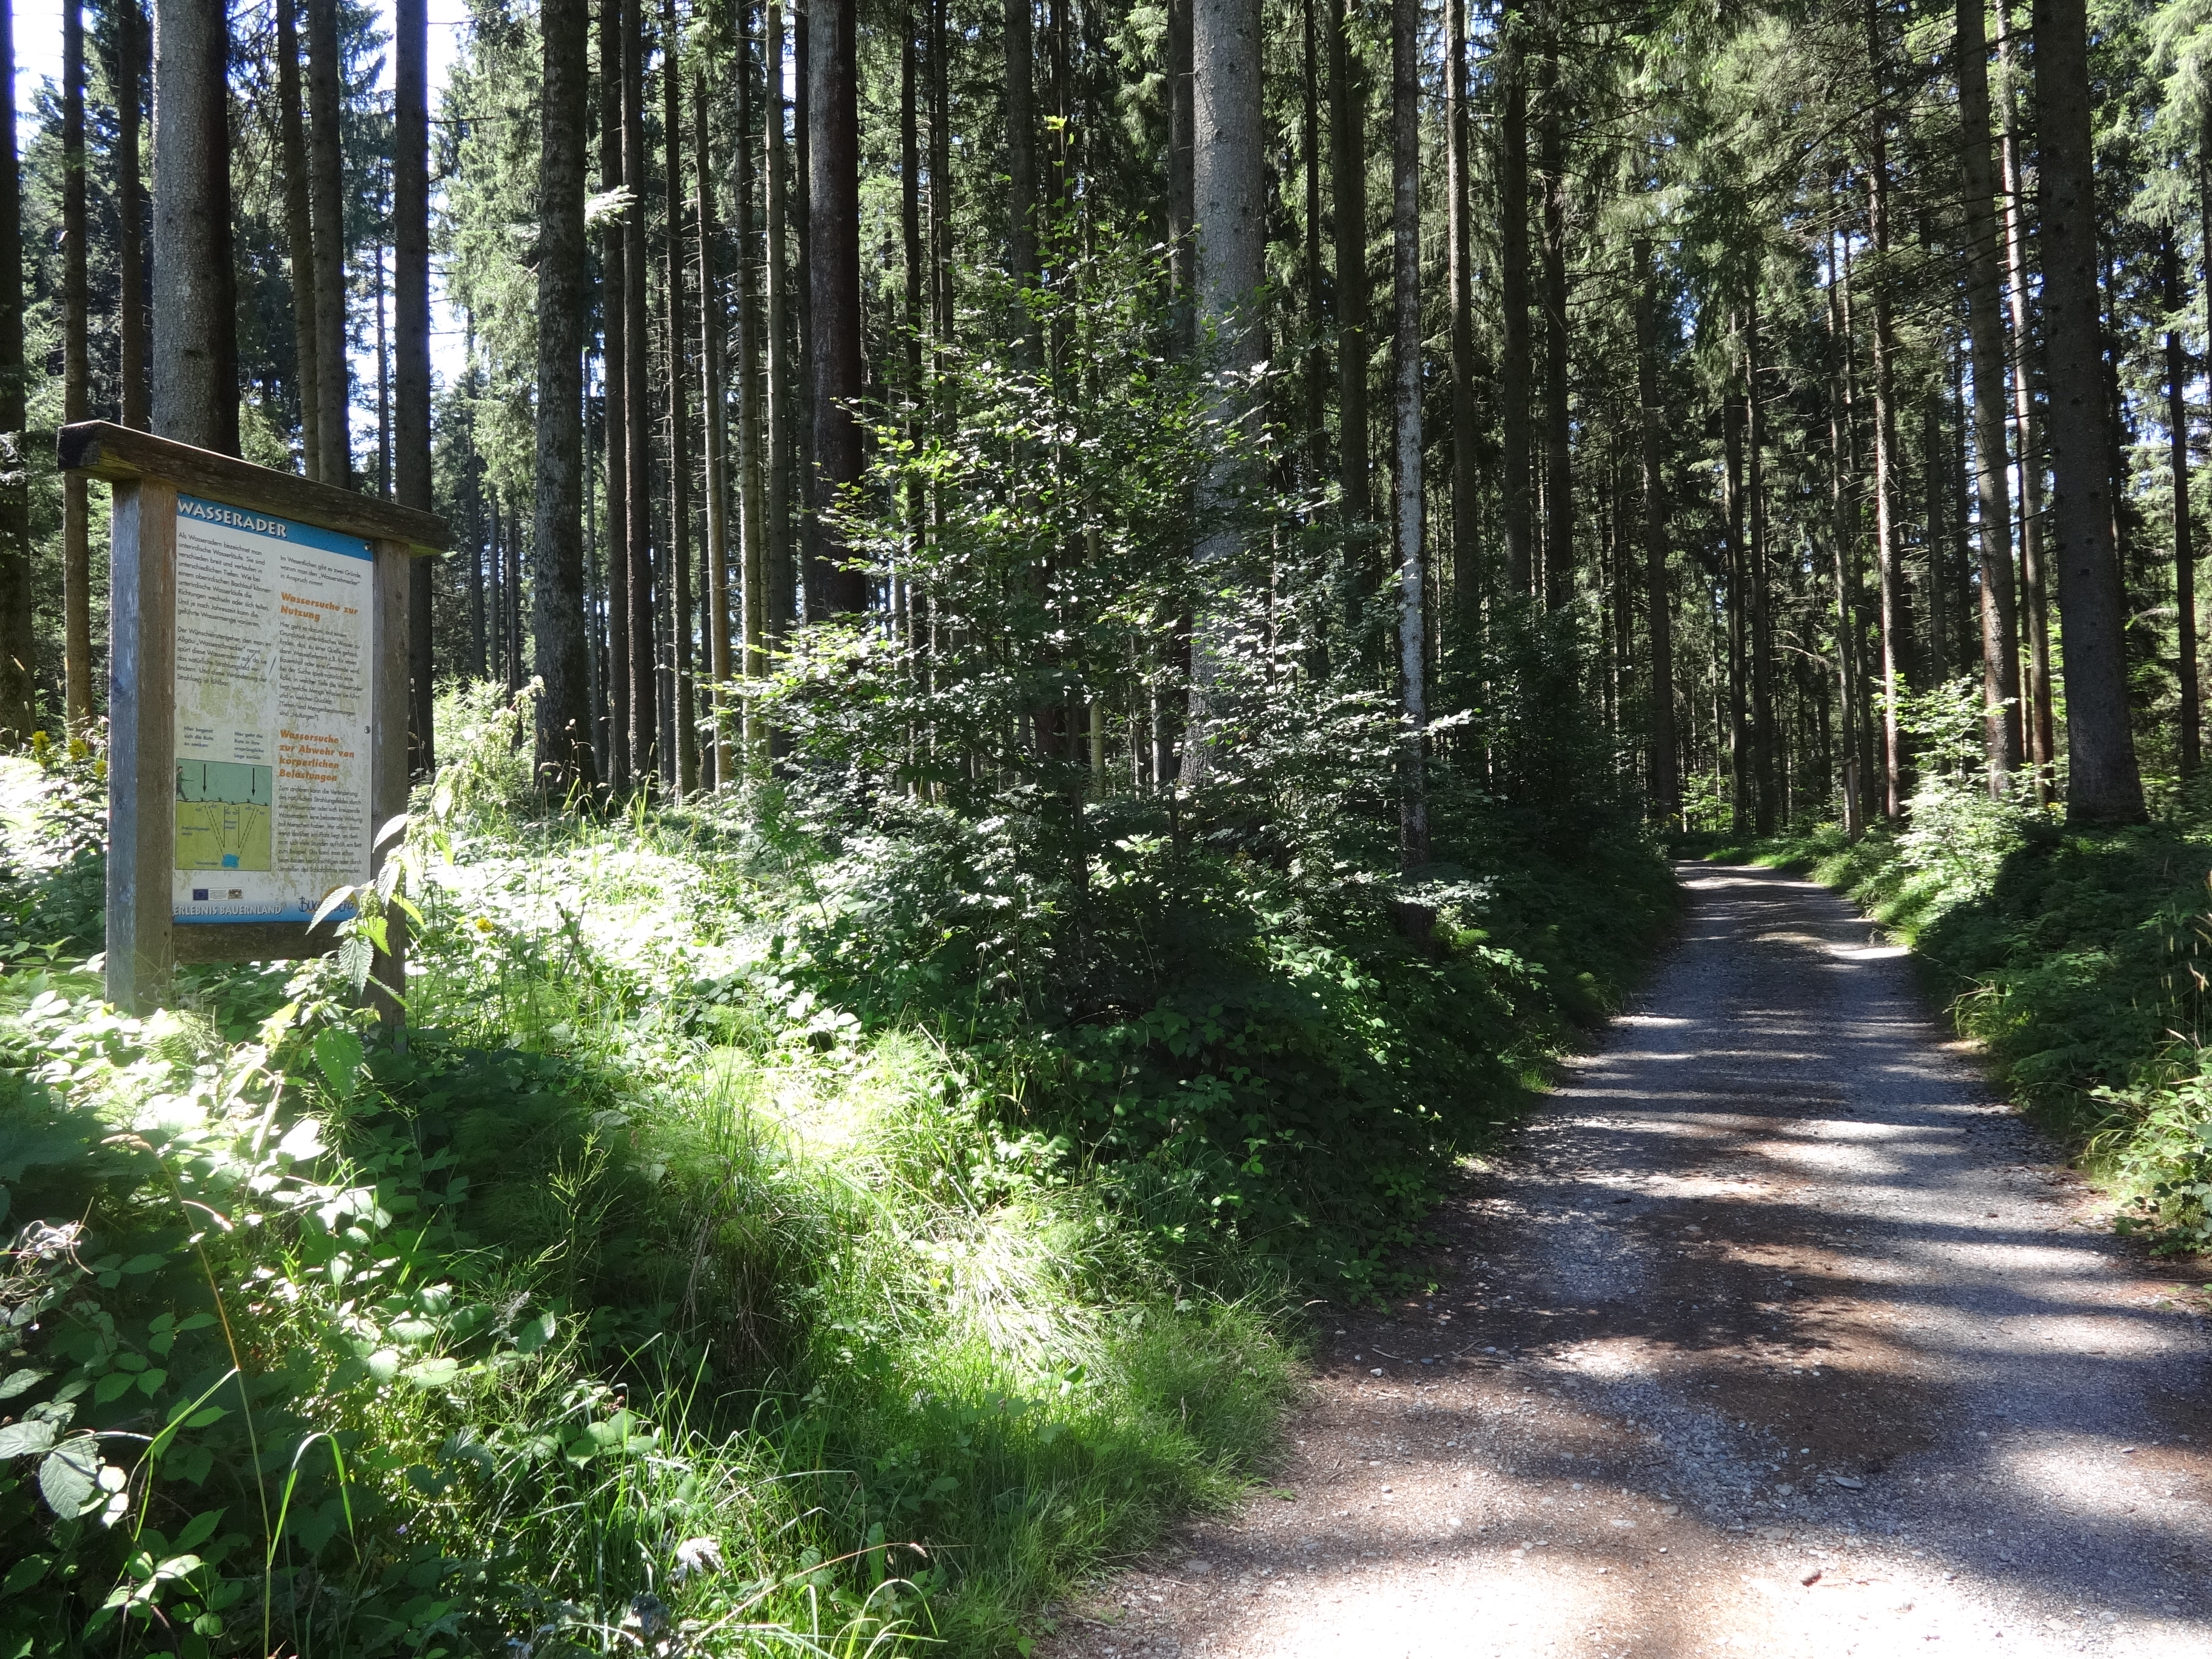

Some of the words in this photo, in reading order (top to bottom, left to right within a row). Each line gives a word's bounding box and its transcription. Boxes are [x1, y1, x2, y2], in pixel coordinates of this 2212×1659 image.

[177, 498, 287, 538] WASSERADER
[189, 534, 222, 546] Wasseradern
[224, 542, 250, 552] bezeichnet
[178, 541, 211, 554] unterirdische
[213, 549, 244, 561] Wasserläufe.
[178, 551, 209, 562] verschieden
[234, 562, 256, 572] verlaufen
[178, 560, 221, 574] unterschiedlichen
[287, 557, 317, 568] Wesentlichen
[345, 569, 362, 579] Gründe,
[178, 569, 193, 578] einem
[195, 573, 229, 585] oberirdischen
[231, 580, 252, 589] Bachlauf
[253, 585, 270, 593] können
[286, 574, 307, 585] Anspruch
[178, 579, 210, 590] unterirdische
[212, 586, 243, 596] Wasserläufe
[178, 588, 206, 601] Richtungen
[208, 594, 230, 603] wechseln
[281, 592, 340, 611] Wassersuche
[190, 600, 195, 608] je
[211, 604, 235, 613] Jahreszeit
[281, 605, 320, 622] Nutzung
[178, 607, 199, 618] geführte
[201, 611, 236, 625] Wassermenge
[280, 629, 306, 639] Grundstück
[291, 623, 301, 631] geht
[177, 635, 195, 646] Allgäu
[177, 645, 190, 654] spürt
[207, 649, 240, 660] Wasseradern
[189, 656, 213, 665] natürliche
[215, 660, 249, 672] Strahlungsfeld
[280, 656, 303, 665] Bauernhof
[327, 663, 348, 672] Gemeinde
[177, 673, 201, 684] Strahlung
[226, 671, 257, 682] Veränderung
[309, 687, 324, 695] Menge
[337, 682, 363, 691] Wasserader
[280, 729, 339, 743] Wassersuche
[298, 745, 335, 756] Abwehr
[280, 756, 339, 771] körperlichen
[280, 768, 337, 783] Belastungen
[330, 789, 357, 797] Veränderung
[174, 905, 216, 915] ERLEBNIS
[220, 905, 281, 915] BAUERNLAND
